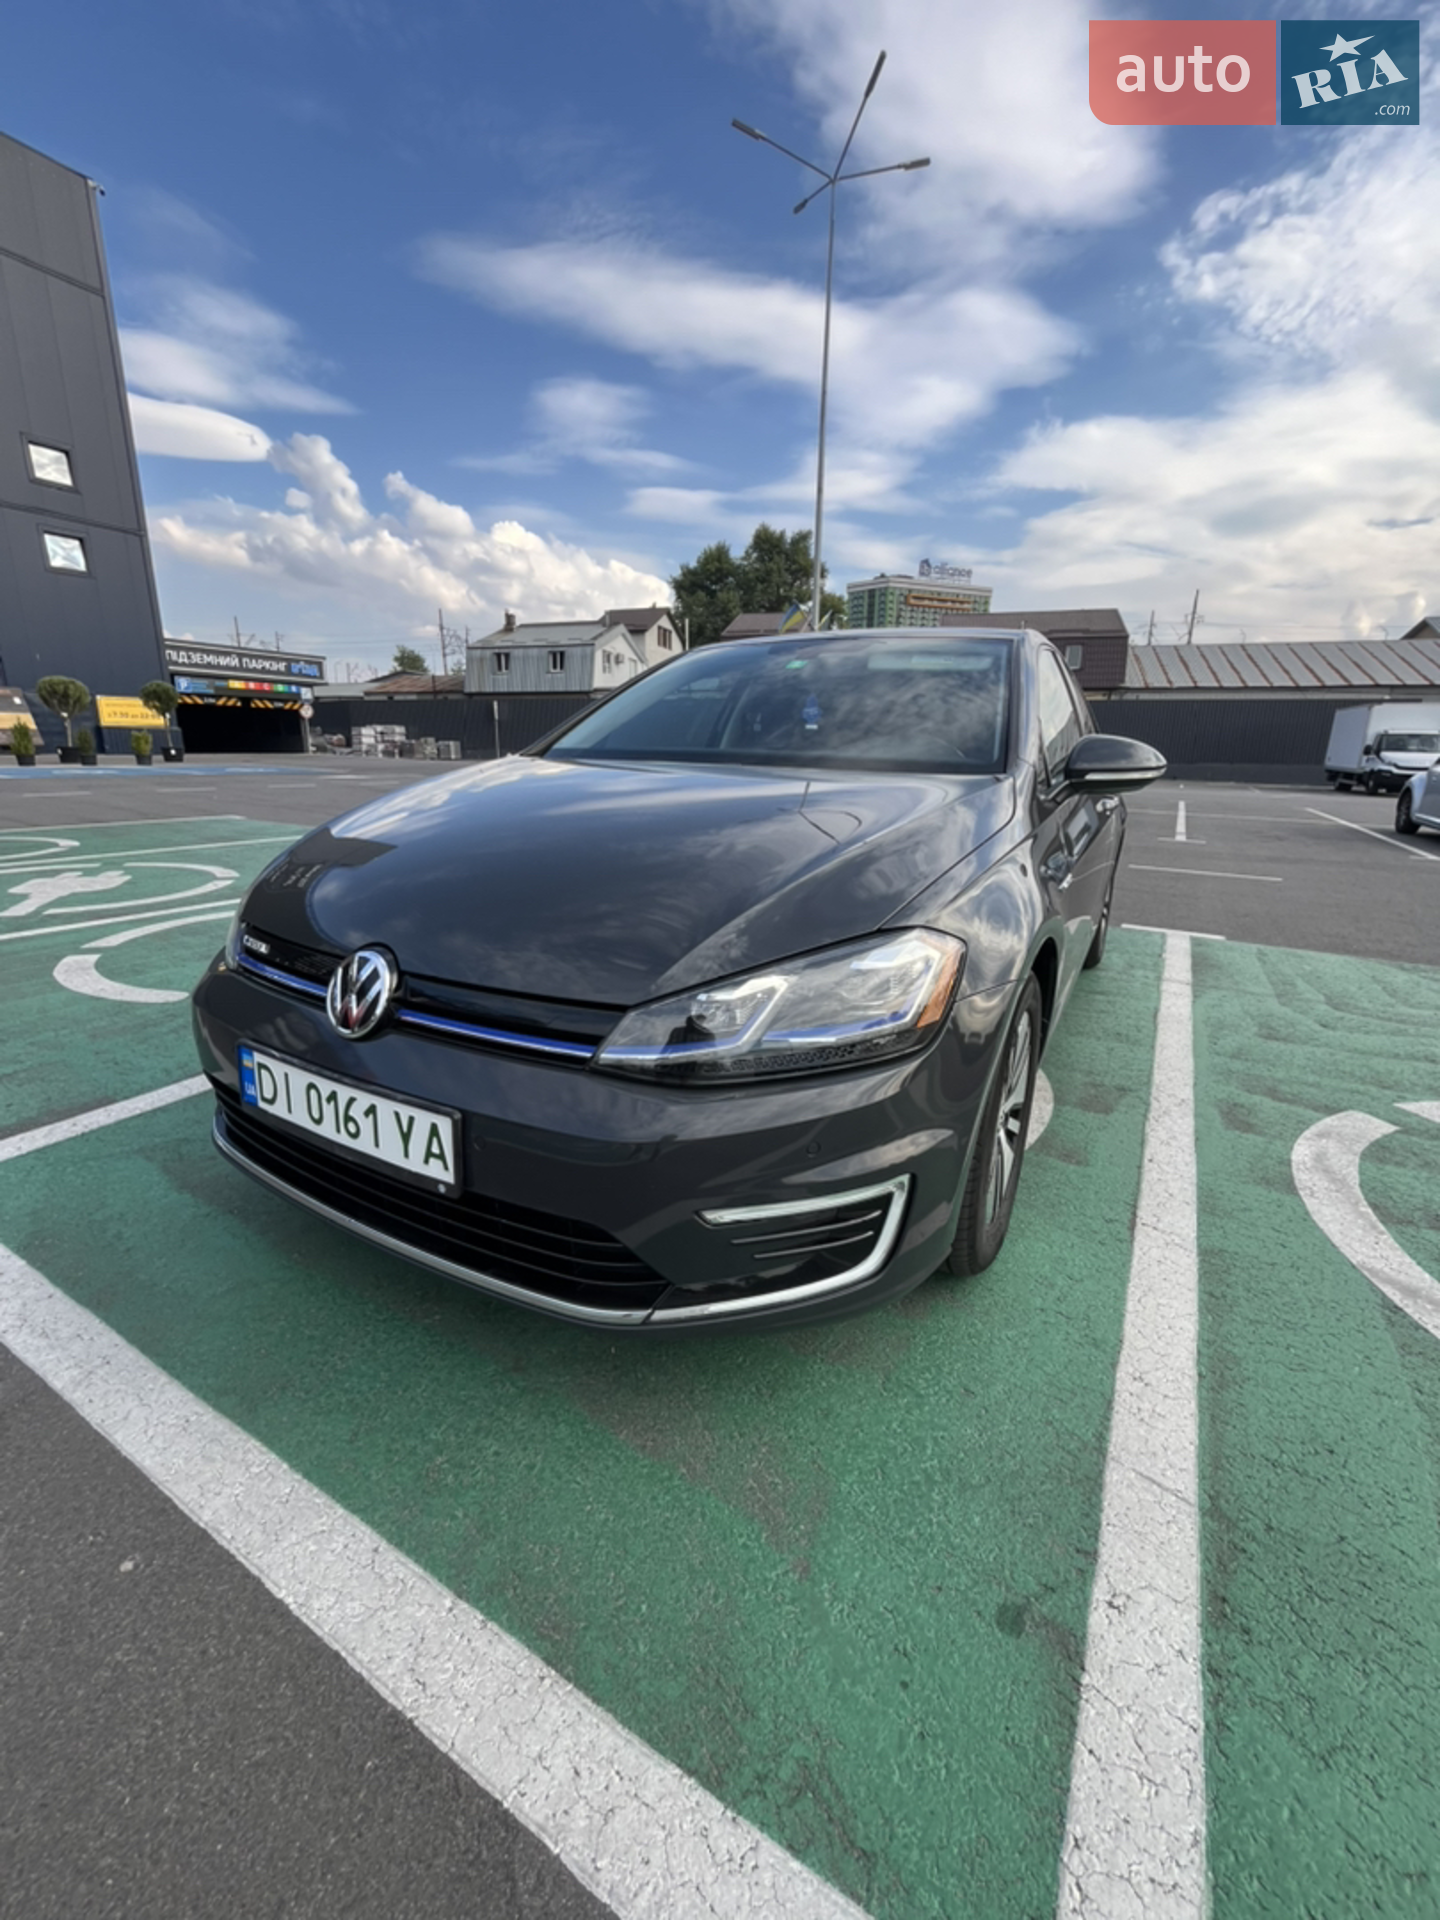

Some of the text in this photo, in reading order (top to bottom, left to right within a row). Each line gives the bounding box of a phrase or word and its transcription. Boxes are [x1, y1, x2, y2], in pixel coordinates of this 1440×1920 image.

[165, 649, 239, 668] ПІДЗЕМНИЙ
[242, 657, 287, 672] ПАРКІНГ
[256, 1060, 450, 1172] DI 0161 YA
